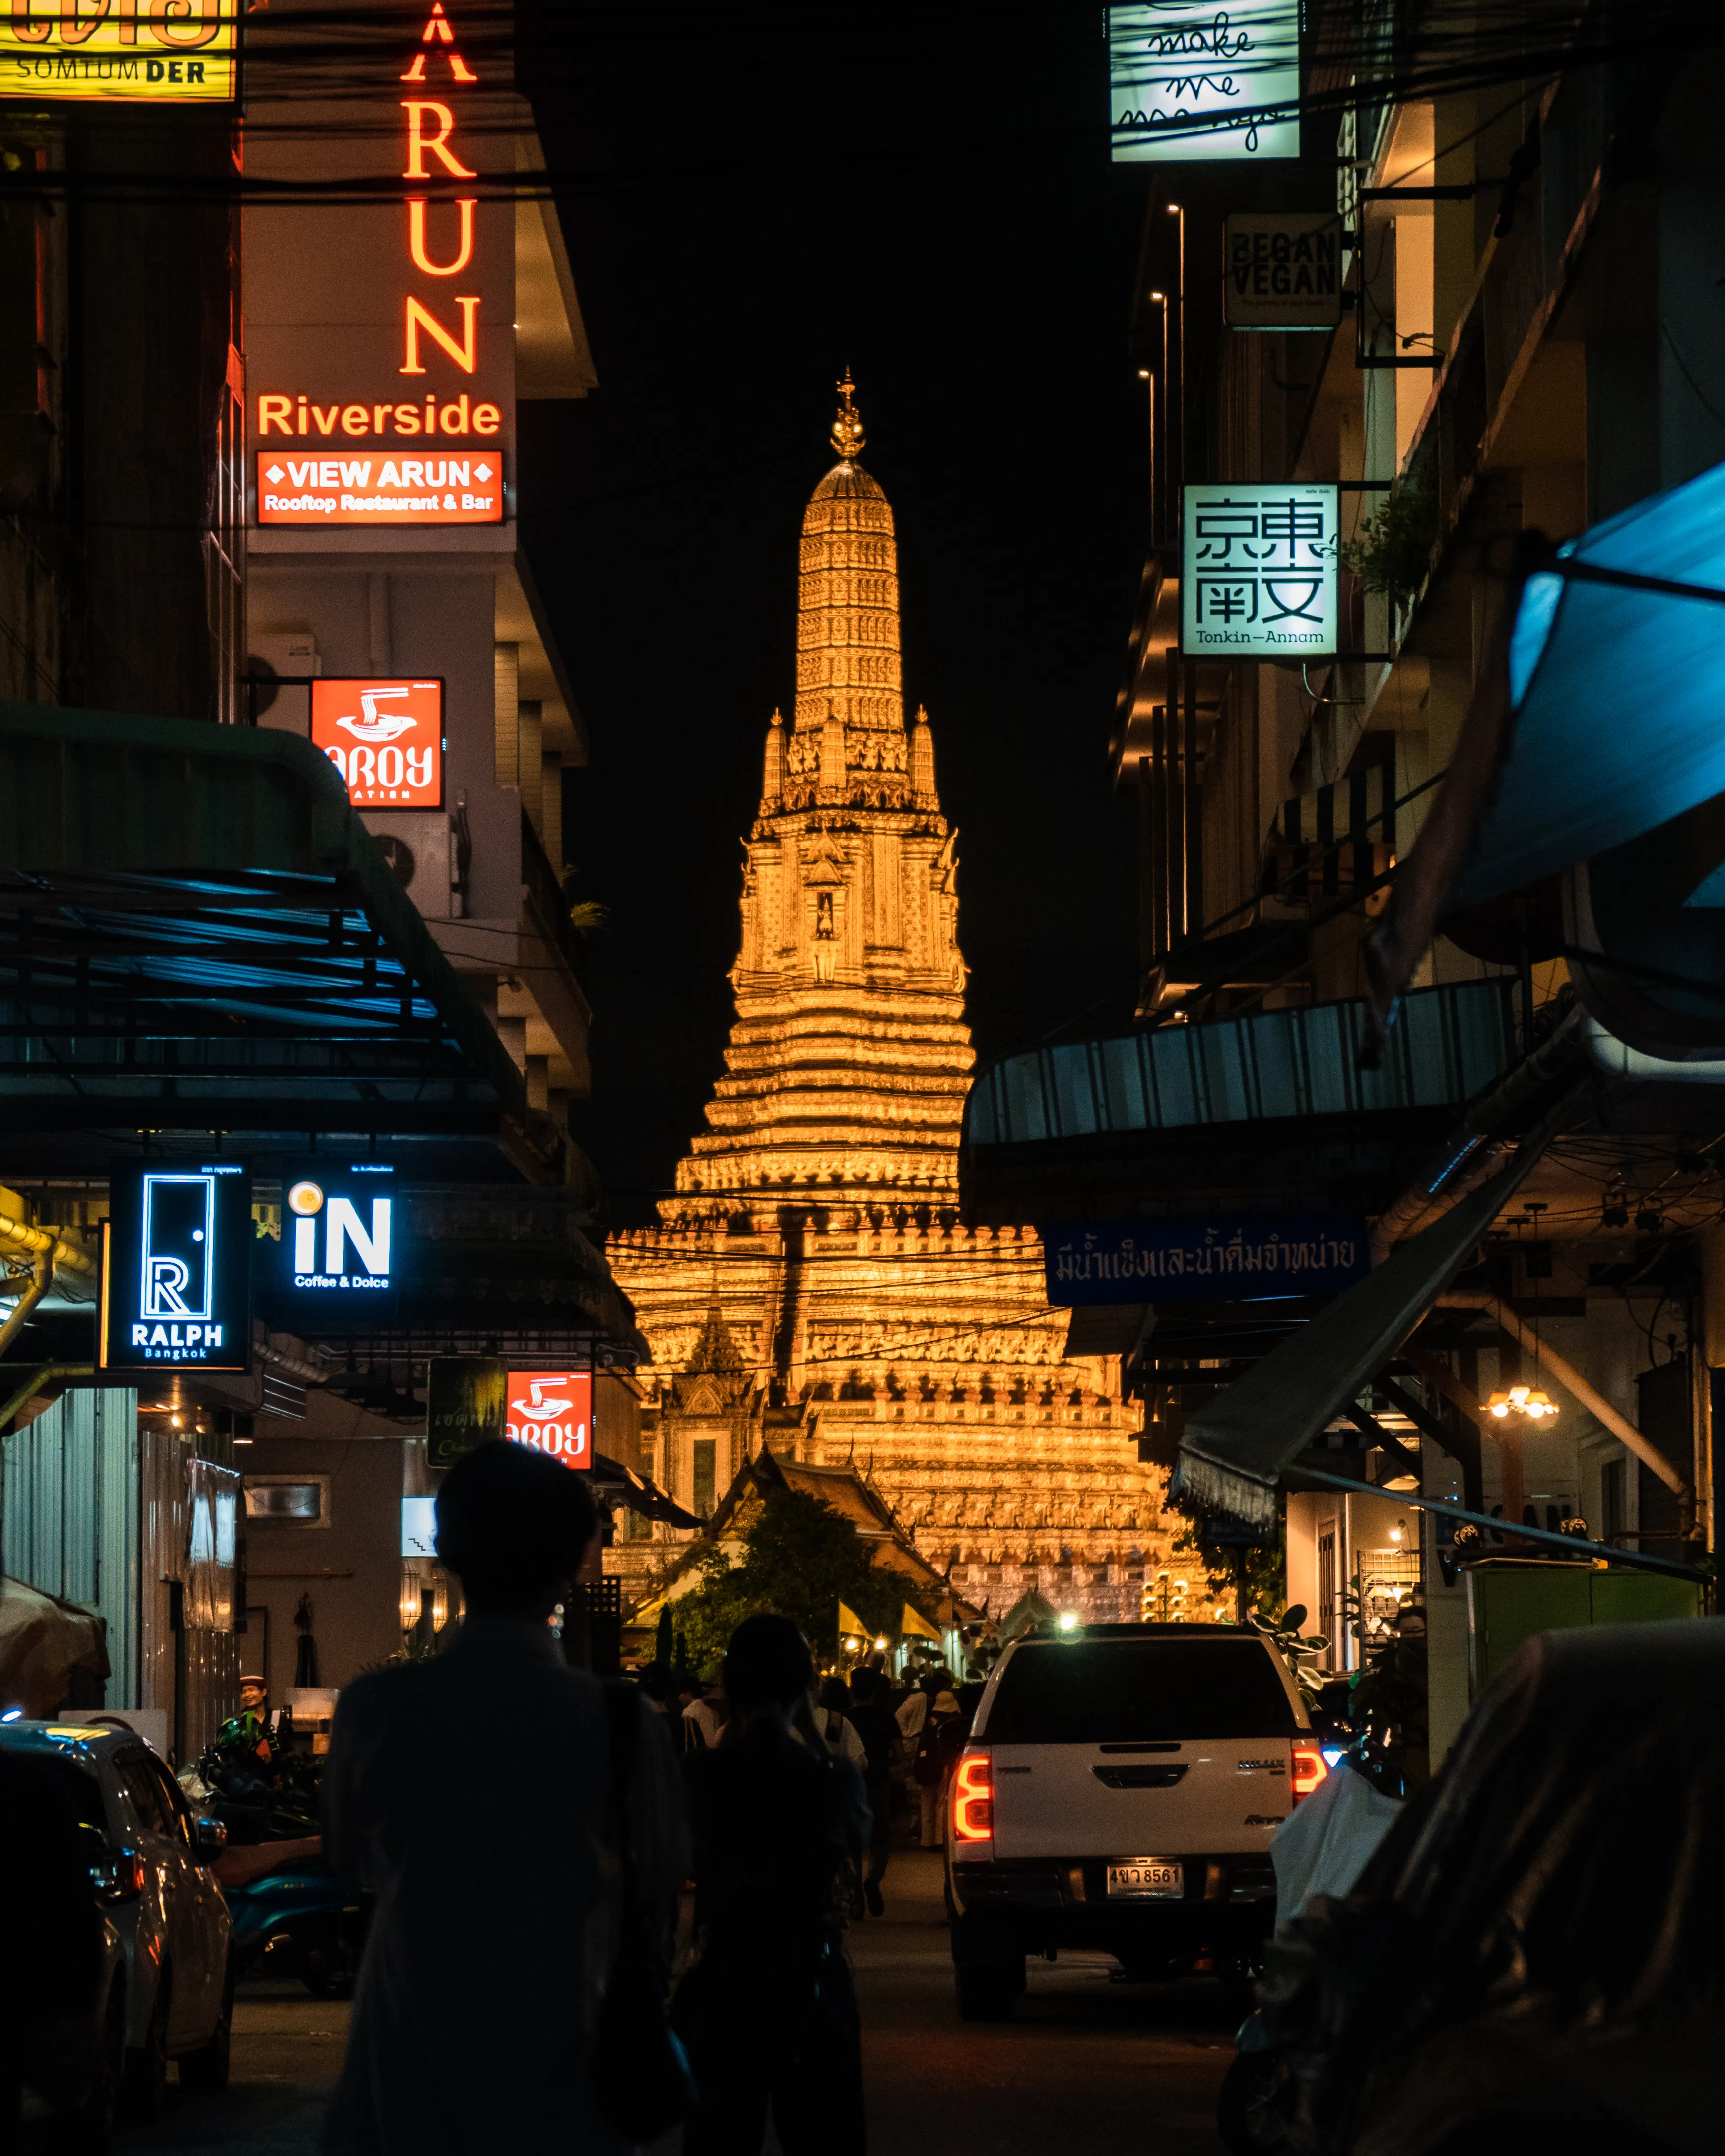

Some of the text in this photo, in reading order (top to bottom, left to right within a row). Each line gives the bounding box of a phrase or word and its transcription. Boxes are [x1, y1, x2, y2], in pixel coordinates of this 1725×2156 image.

[1148, 12, 1256, 58] make
[16, 57, 205, 83] SOMTUM DER
[1166, 76, 1240, 100] me
[399, 3, 481, 374] ARUN
[1232, 232, 1336, 263] BEGAN
[1232, 264, 1336, 295] VEGAN
[258, 394, 500, 436] Riverside
[287, 461, 470, 488] VIEW ARUN
[265, 493, 494, 514] Rooftop Restaurant & Bar
[354, 790, 410, 799] ATIEN
[1056, 1227, 1356, 1281] มีน้ำแข็งและน้ำดื่มจำหน่าย
[295, 1275, 389, 1288] Coffee & Dolce
[132, 1324, 222, 1347] RALPH
[144, 1348, 207, 1360] Bangkok
[1143, 1868, 1178, 1883] 8561
